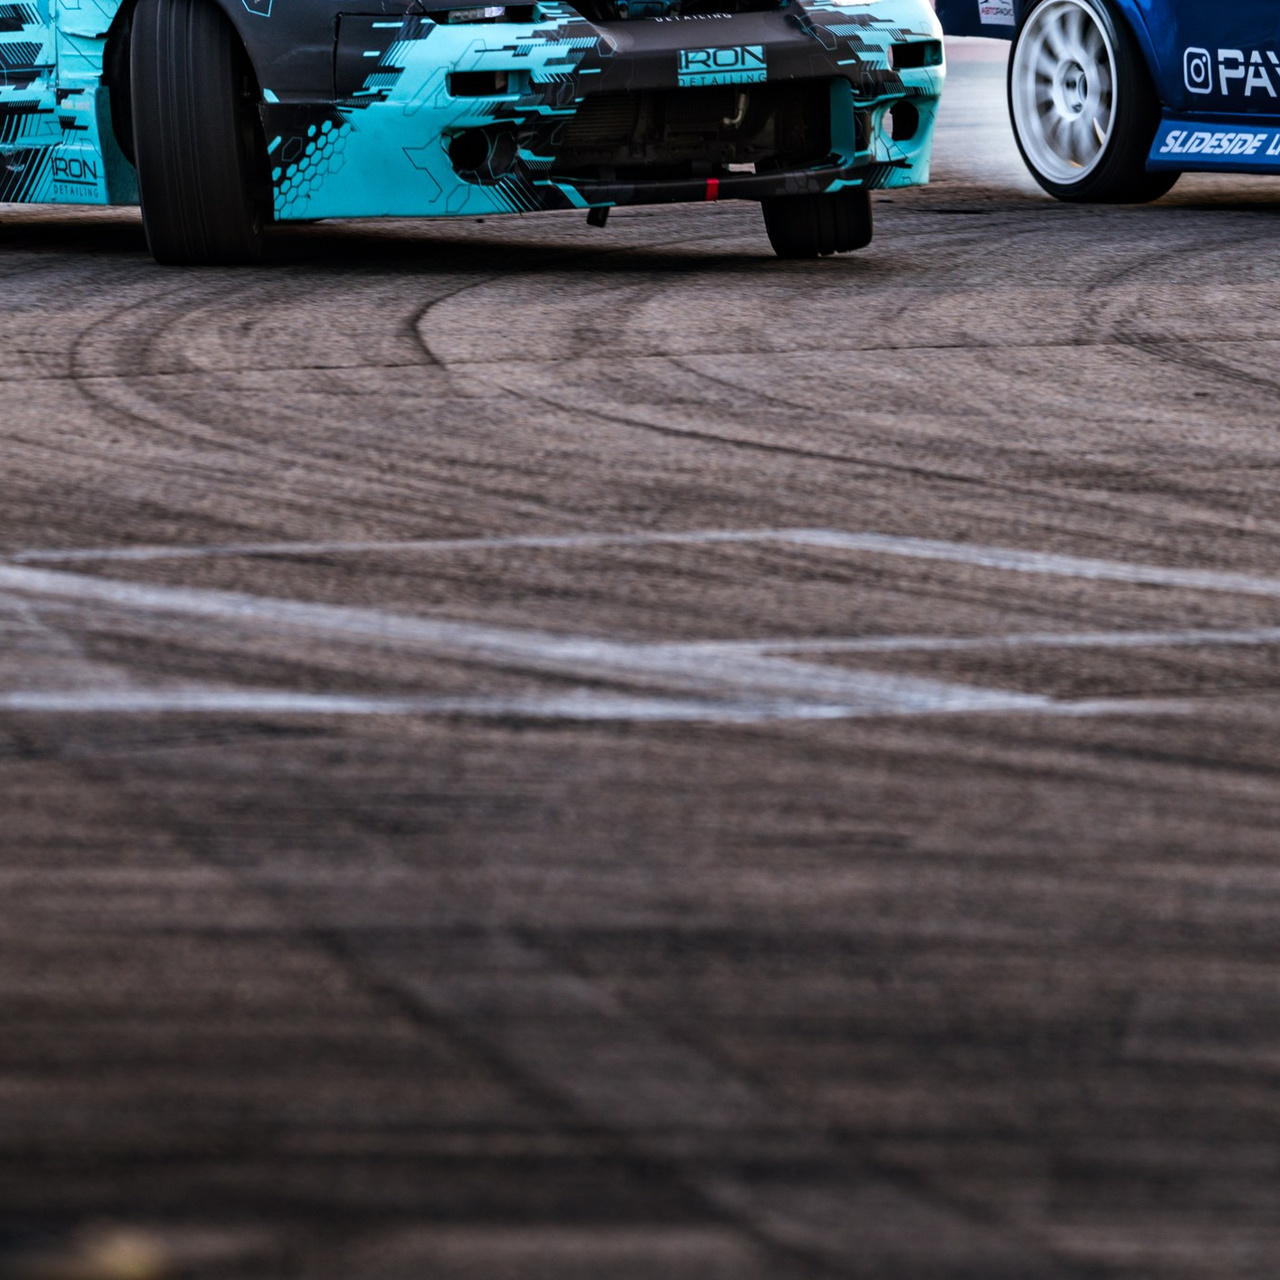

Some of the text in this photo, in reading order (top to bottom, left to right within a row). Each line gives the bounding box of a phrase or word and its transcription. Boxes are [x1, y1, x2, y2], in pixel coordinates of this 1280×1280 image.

[655, 13, 733, 22] DETAILING
[679, 45, 767, 70] IRON
[678, 72, 767, 87] DETAILING
[1159, 130, 1268, 155] SLIDESIDE
[51, 157, 97, 179] IRON
[54, 185, 98, 198] DETAILING
